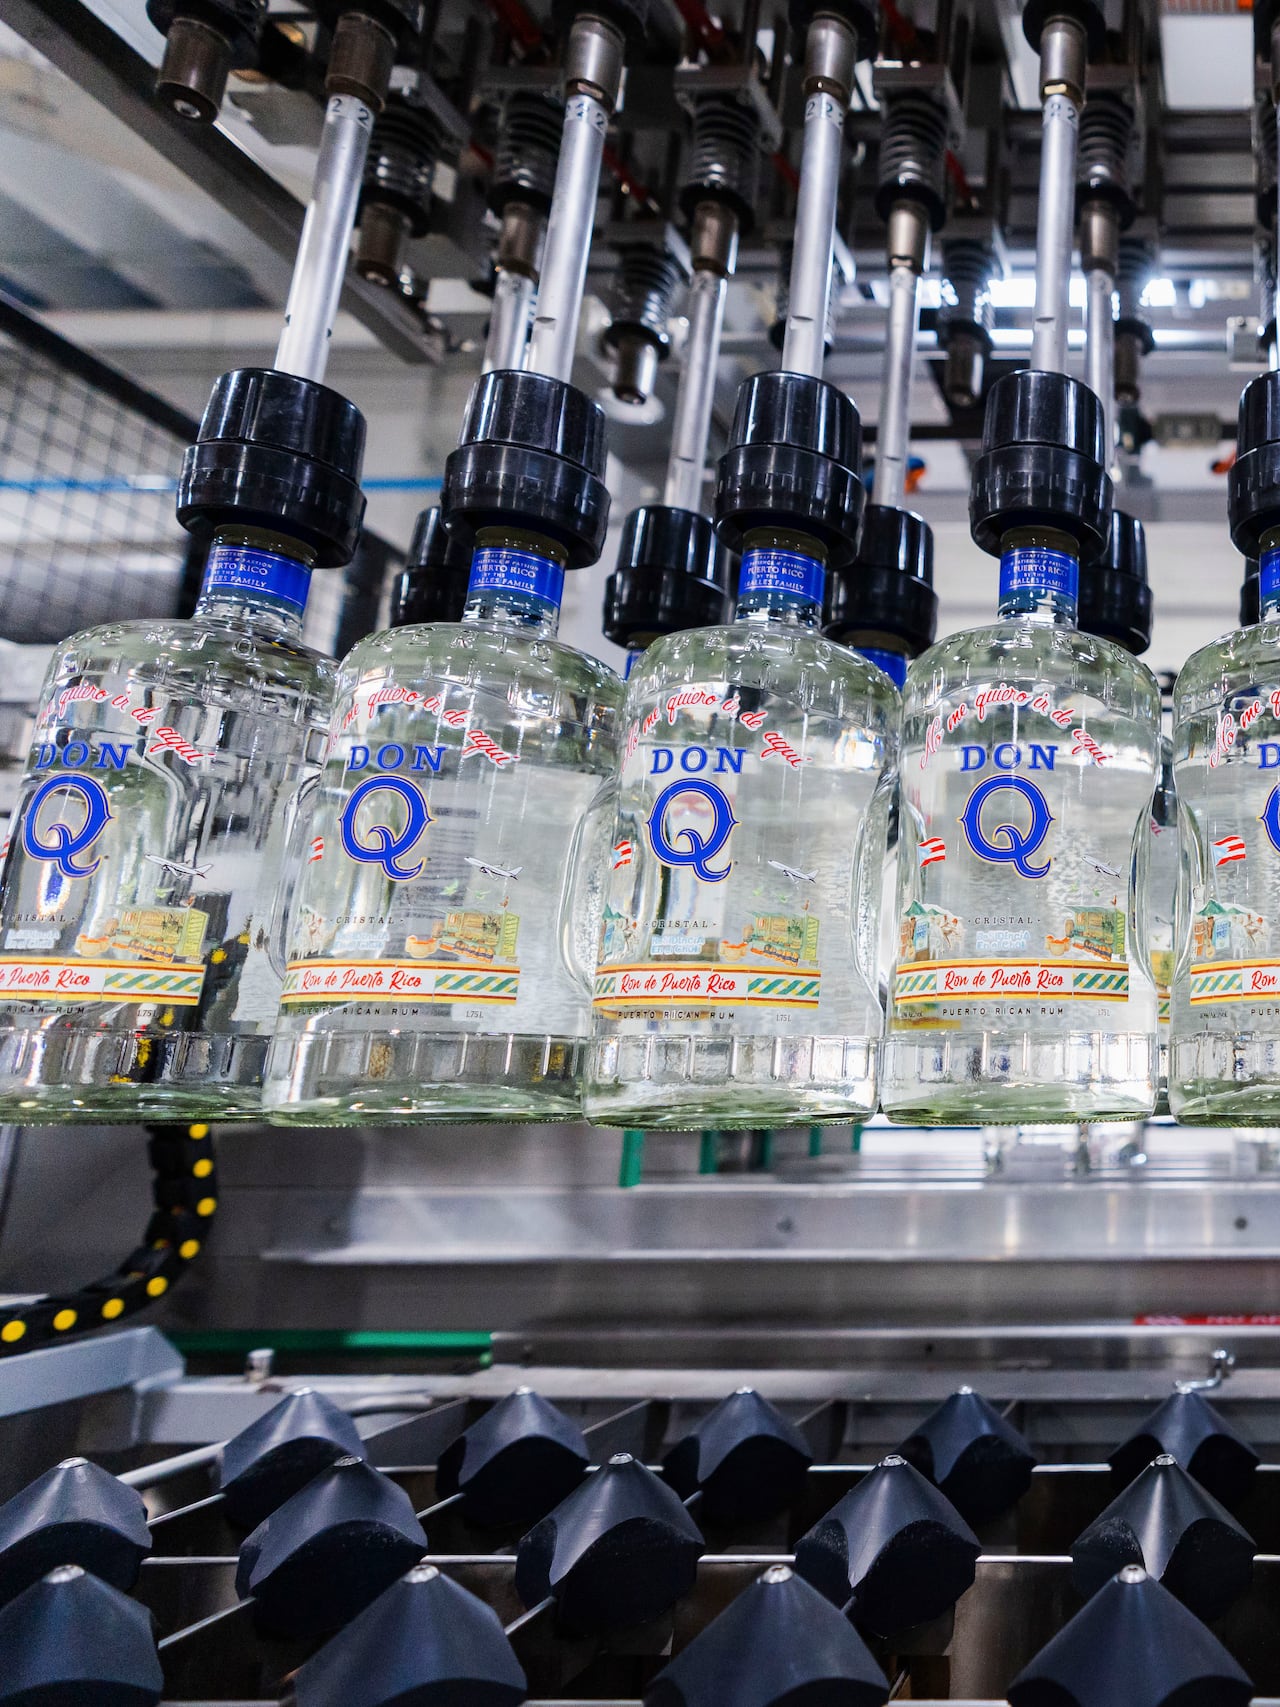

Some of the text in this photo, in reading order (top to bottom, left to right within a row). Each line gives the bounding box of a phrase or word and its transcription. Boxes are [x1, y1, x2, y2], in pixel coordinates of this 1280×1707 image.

[240, 564, 268, 576] RICO
[510, 567, 536, 578] RICO
[747, 566, 805, 579] PUERTO RICO
[1013, 564, 1046, 572] PUERTO
[231, 576, 267, 588] FAMILY
[502, 578, 535, 590] FAMILY
[775, 579, 804, 591] FAMILY
[59, 682, 109, 717] quiero
[111, 691, 131, 711] ir
[131, 706, 161, 725] de
[343, 703, 360, 729] me
[367, 683, 423, 718] quiero
[423, 694, 442, 712] ir
[443, 709, 471, 726] de
[643, 708, 661, 733] me
[667, 688, 720, 723] quiero
[722, 696, 740, 713] ir
[741, 711, 767, 729] de
[920, 716, 944, 770] No
[948, 704, 967, 731] me
[975, 683, 1031, 720] quiero
[1033, 693, 1050, 713] ir
[1051, 709, 1075, 727] de
[1210, 713, 1236, 769] No
[1240, 700, 1262, 729] me
[35, 741, 132, 769] DON
[347, 744, 446, 771] DON
[650, 746, 746, 774] DON
[960, 743, 1058, 771] DON
[22, 772, 115, 878] Q
[337, 773, 437, 882] Q
[645, 777, 742, 883] Q
[957, 773, 1056, 880] Q
[336, 917, 394, 925] CRISTAL
[652, 920, 708, 929] CRISTAL
[975, 917, 1033, 925] CRISTAL
[7, 967, 90, 989] Puerto Rico
[301, 969, 422, 990] Ron de Puerto Rico
[620, 973, 737, 994] Ron de Puerto Rico
[944, 969, 1064, 990] Ron de Puerto Rico
[1251, 970, 1278, 990] Ron
[618, 1011, 736, 1020] PUERTO RICAN RUM
[943, 1008, 986, 1016] PUERTO
[1041, 1008, 1064, 1016] RUM
